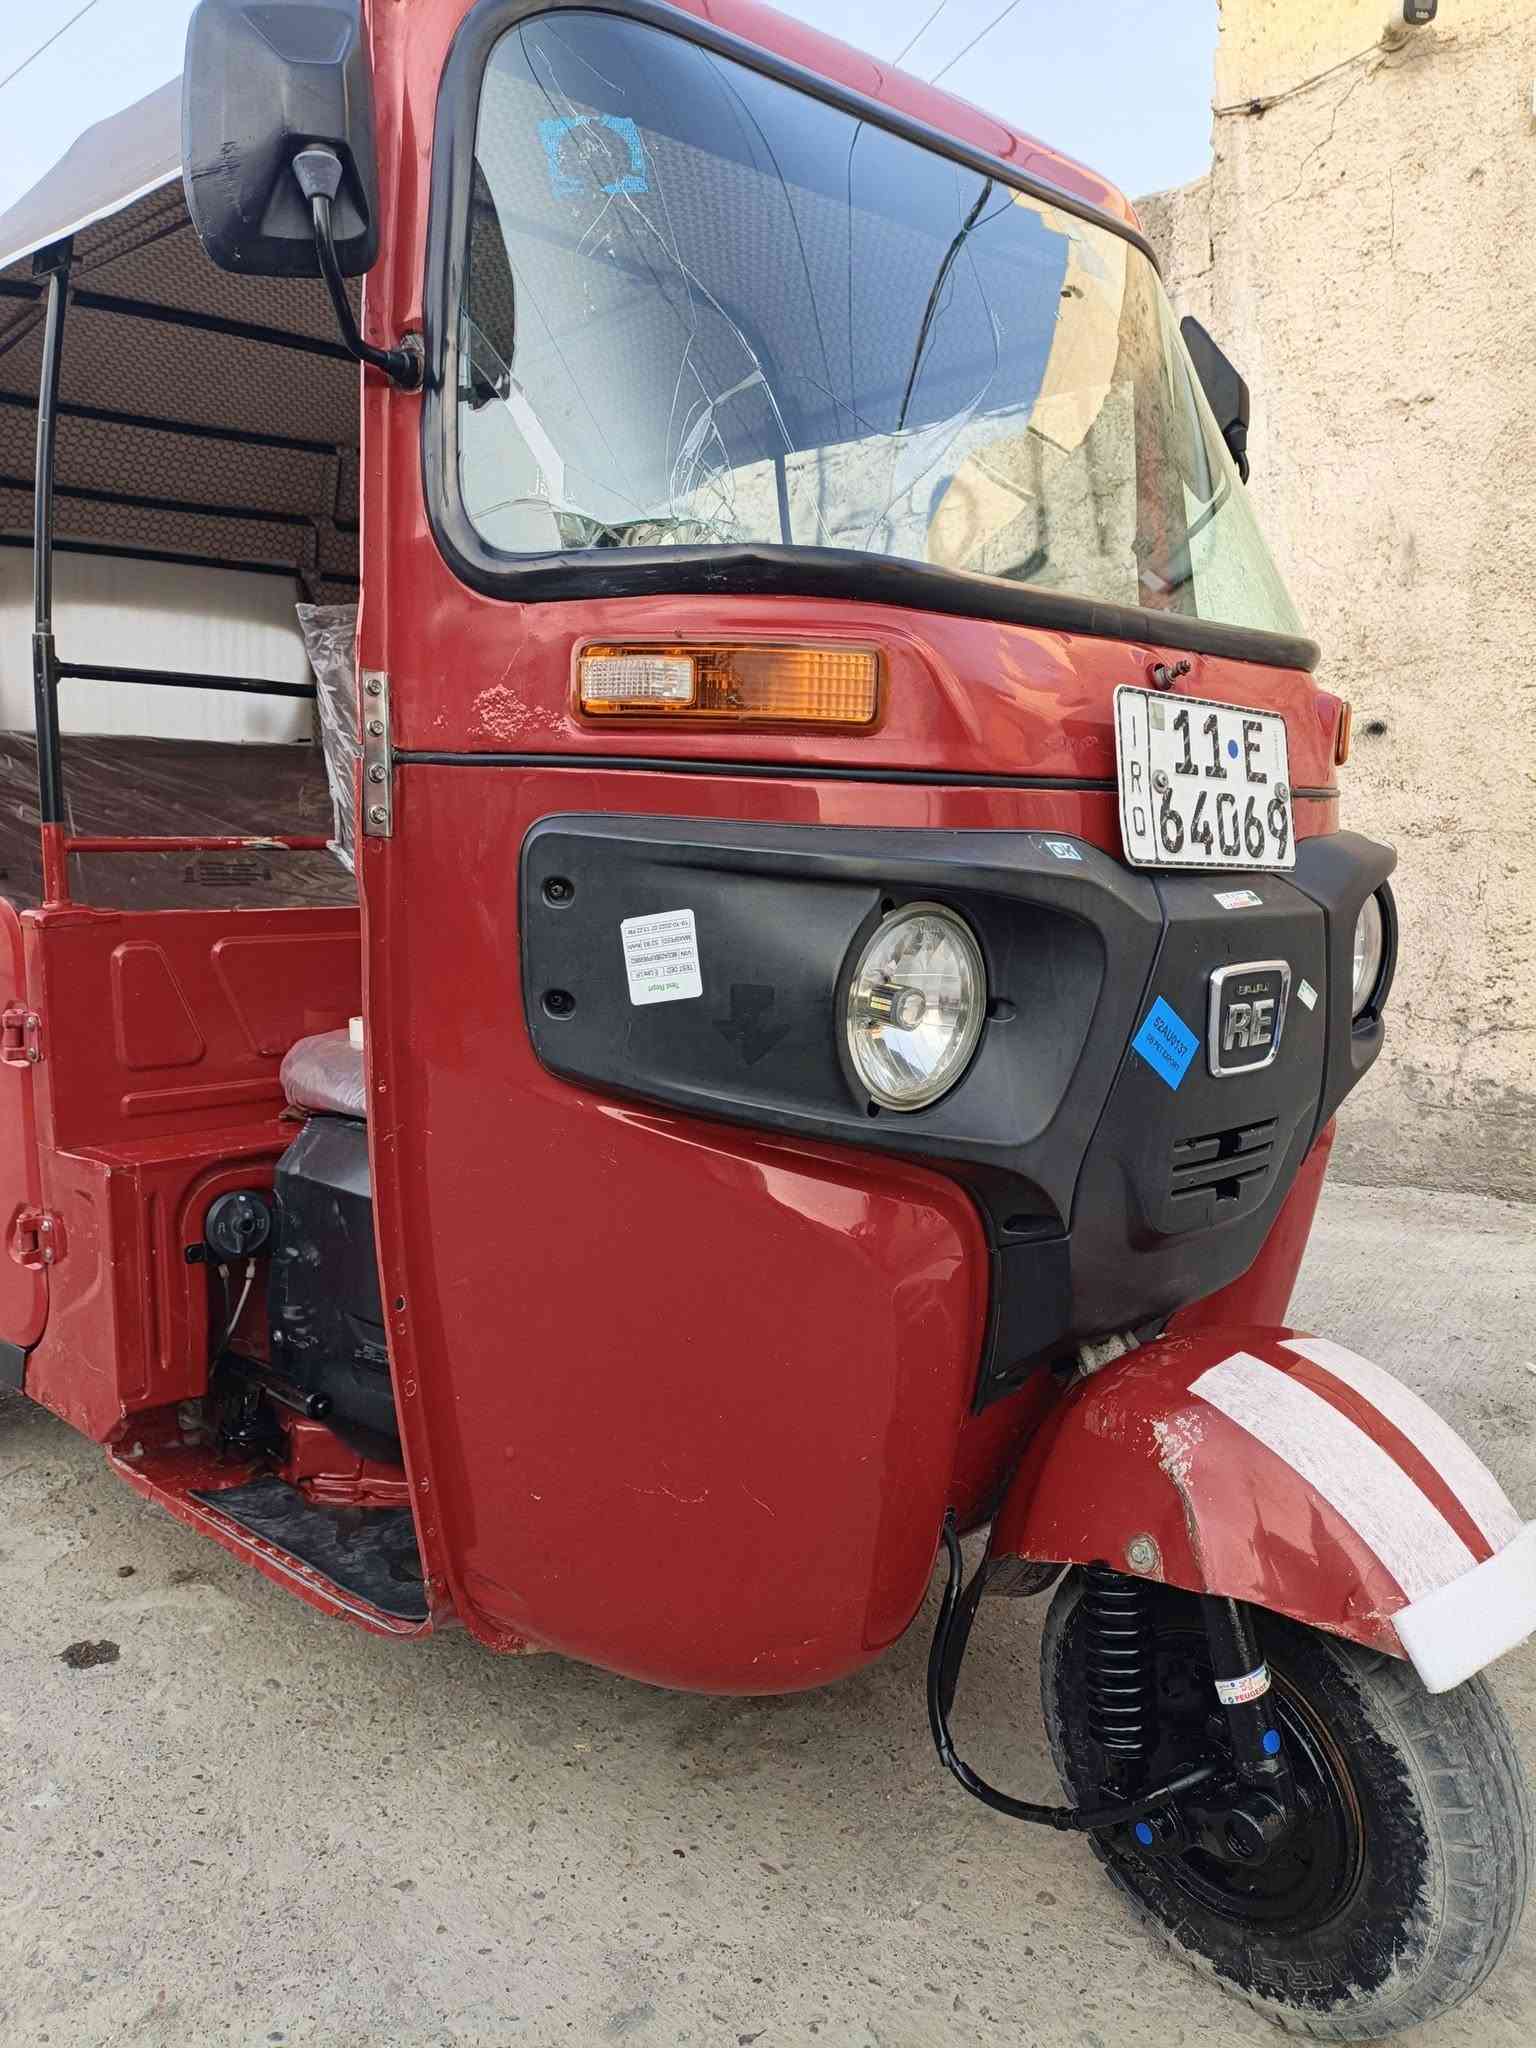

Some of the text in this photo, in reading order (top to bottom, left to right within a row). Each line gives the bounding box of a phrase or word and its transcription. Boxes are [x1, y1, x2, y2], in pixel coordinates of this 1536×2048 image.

[1173, 709, 1227, 779] 11
[1242, 719, 1268, 785] E
[1160, 787, 1289, 860] 64069
[1223, 998, 1275, 1051] RE
